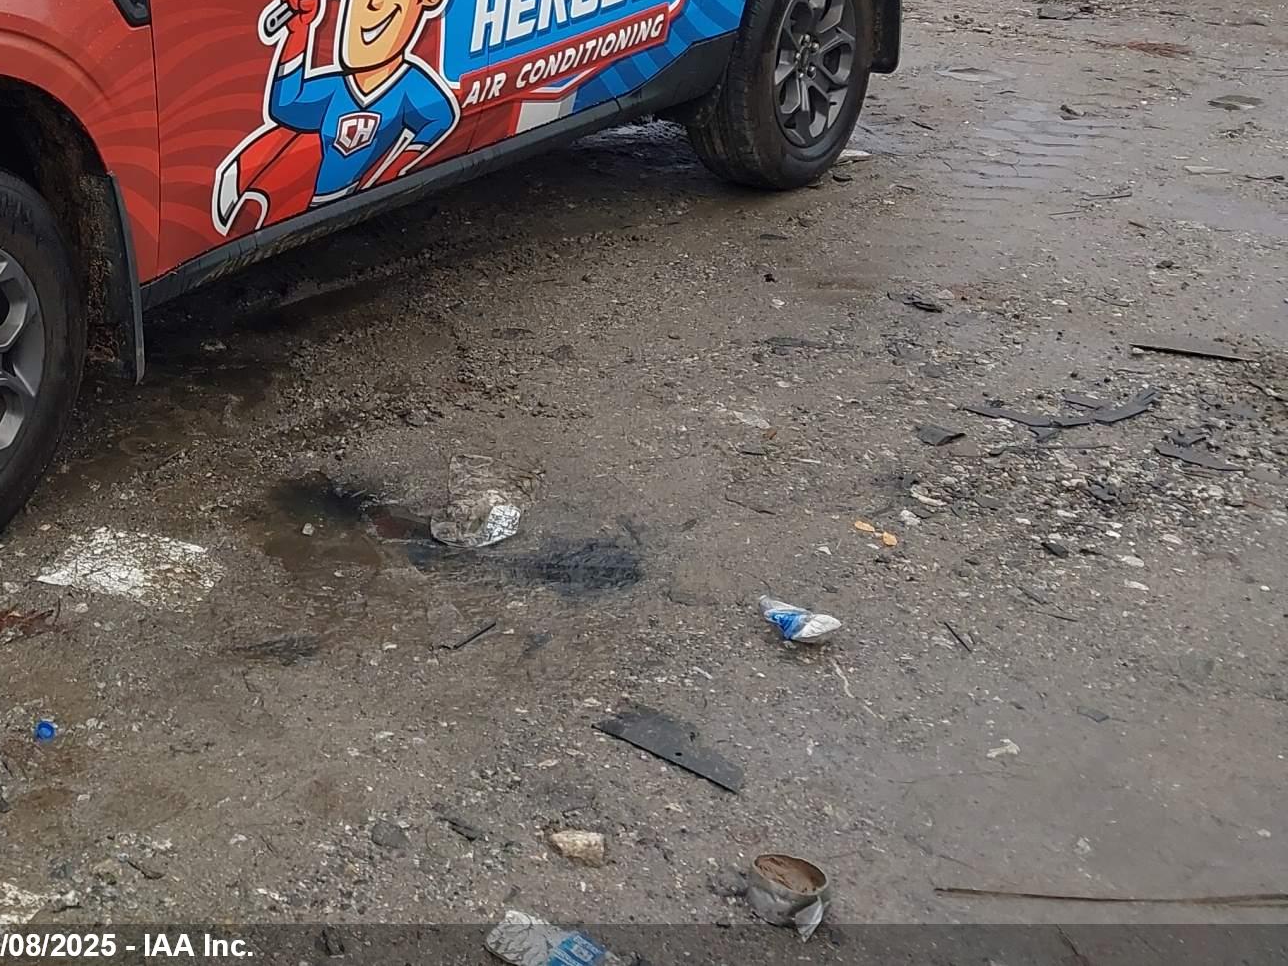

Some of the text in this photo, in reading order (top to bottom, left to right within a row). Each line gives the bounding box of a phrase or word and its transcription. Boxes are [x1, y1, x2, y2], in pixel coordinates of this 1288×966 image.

[462, 13, 665, 108] AIR CONDITIONING
[340, 118, 376, 148] CH
